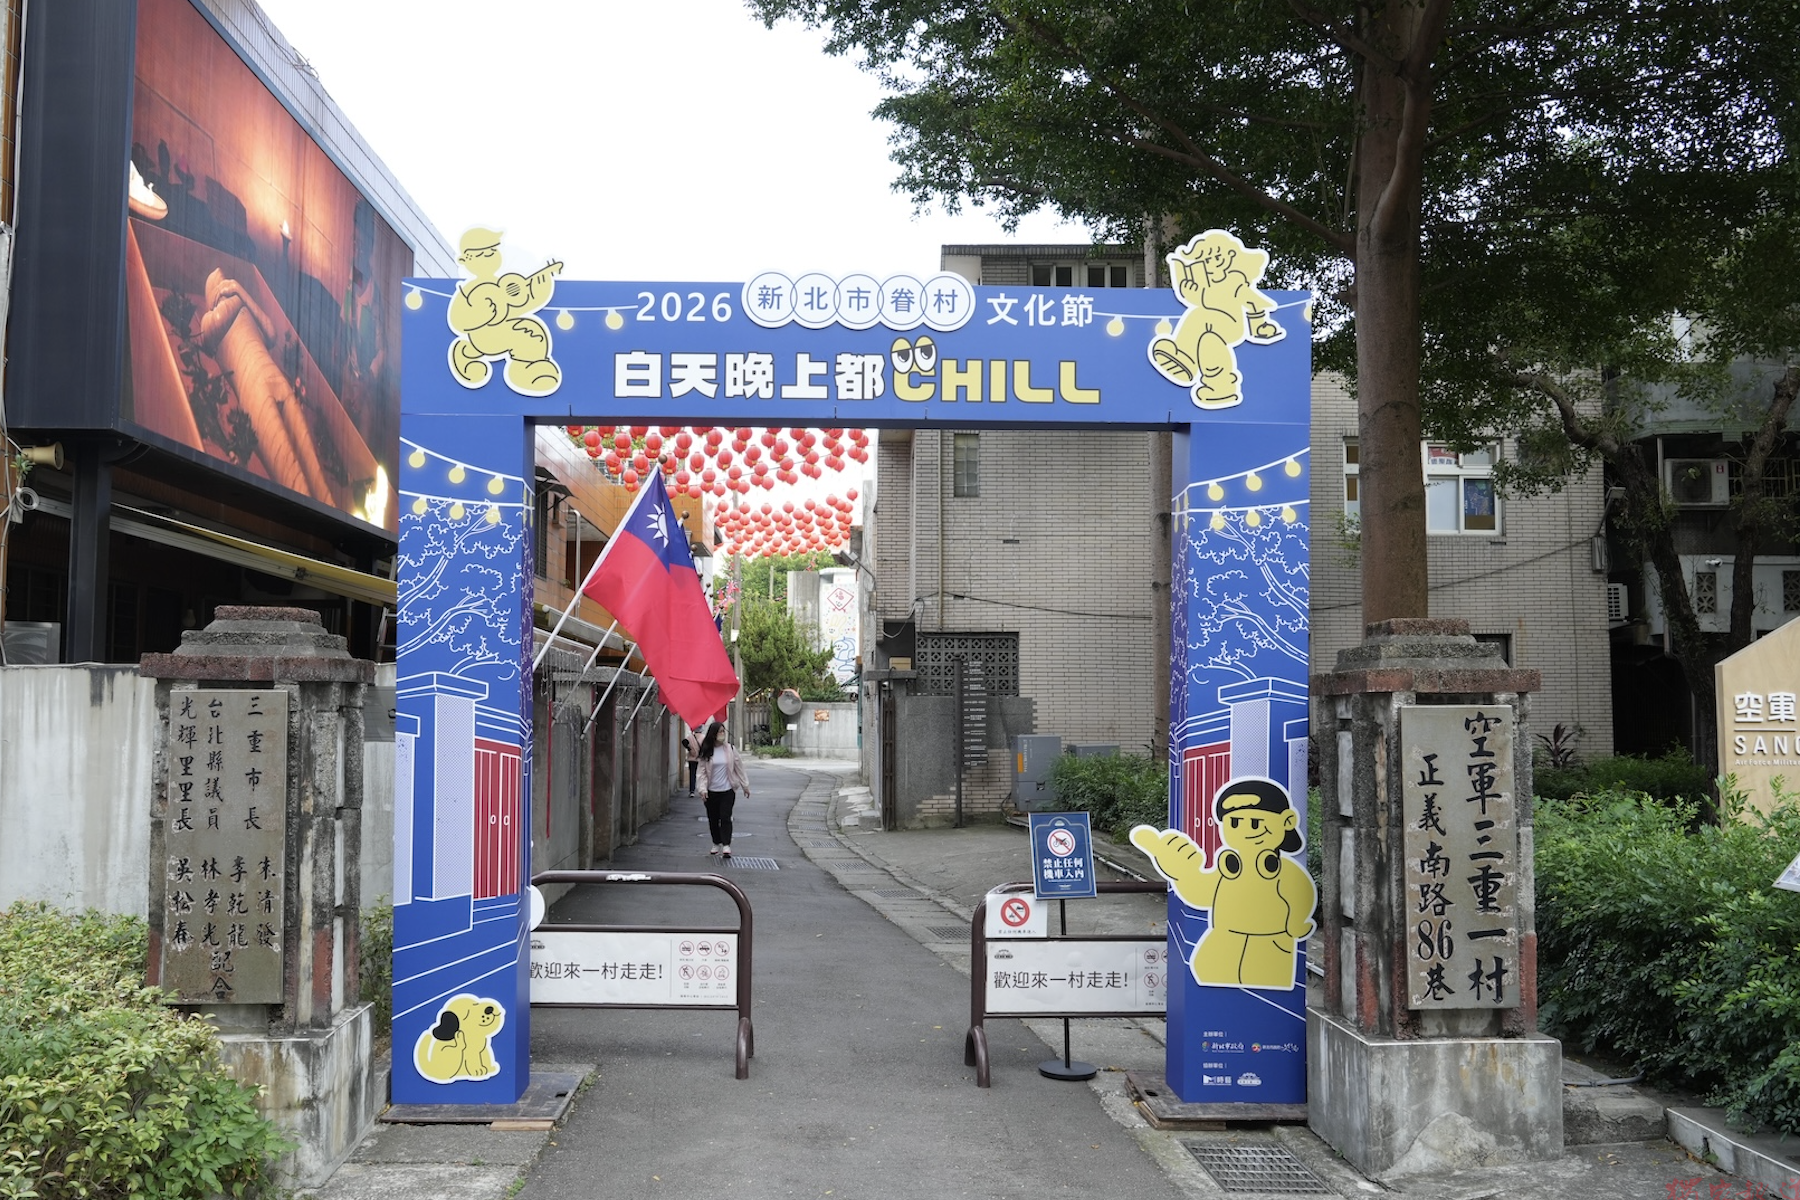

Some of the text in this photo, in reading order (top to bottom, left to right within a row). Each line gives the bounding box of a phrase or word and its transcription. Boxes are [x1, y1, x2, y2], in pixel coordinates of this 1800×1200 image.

[636, 283, 1094, 328] 2026 新北市眷村 文化節
[1734, 691, 1797, 723] 空軍
[176, 696, 198, 830] 光輝里里長
[205, 698, 223, 830] 台北縣議員
[244, 696, 263, 830] 三重市長
[1043, 858, 1083, 868] 禁止任何
[1044, 868, 1084, 879] 機車入內
[1417, 753, 1455, 1002] 正義南路86巷
[1464, 711, 1508, 1004] 空軍三重一村
[994, 971, 1128, 989] 歡迎來一村走走!
